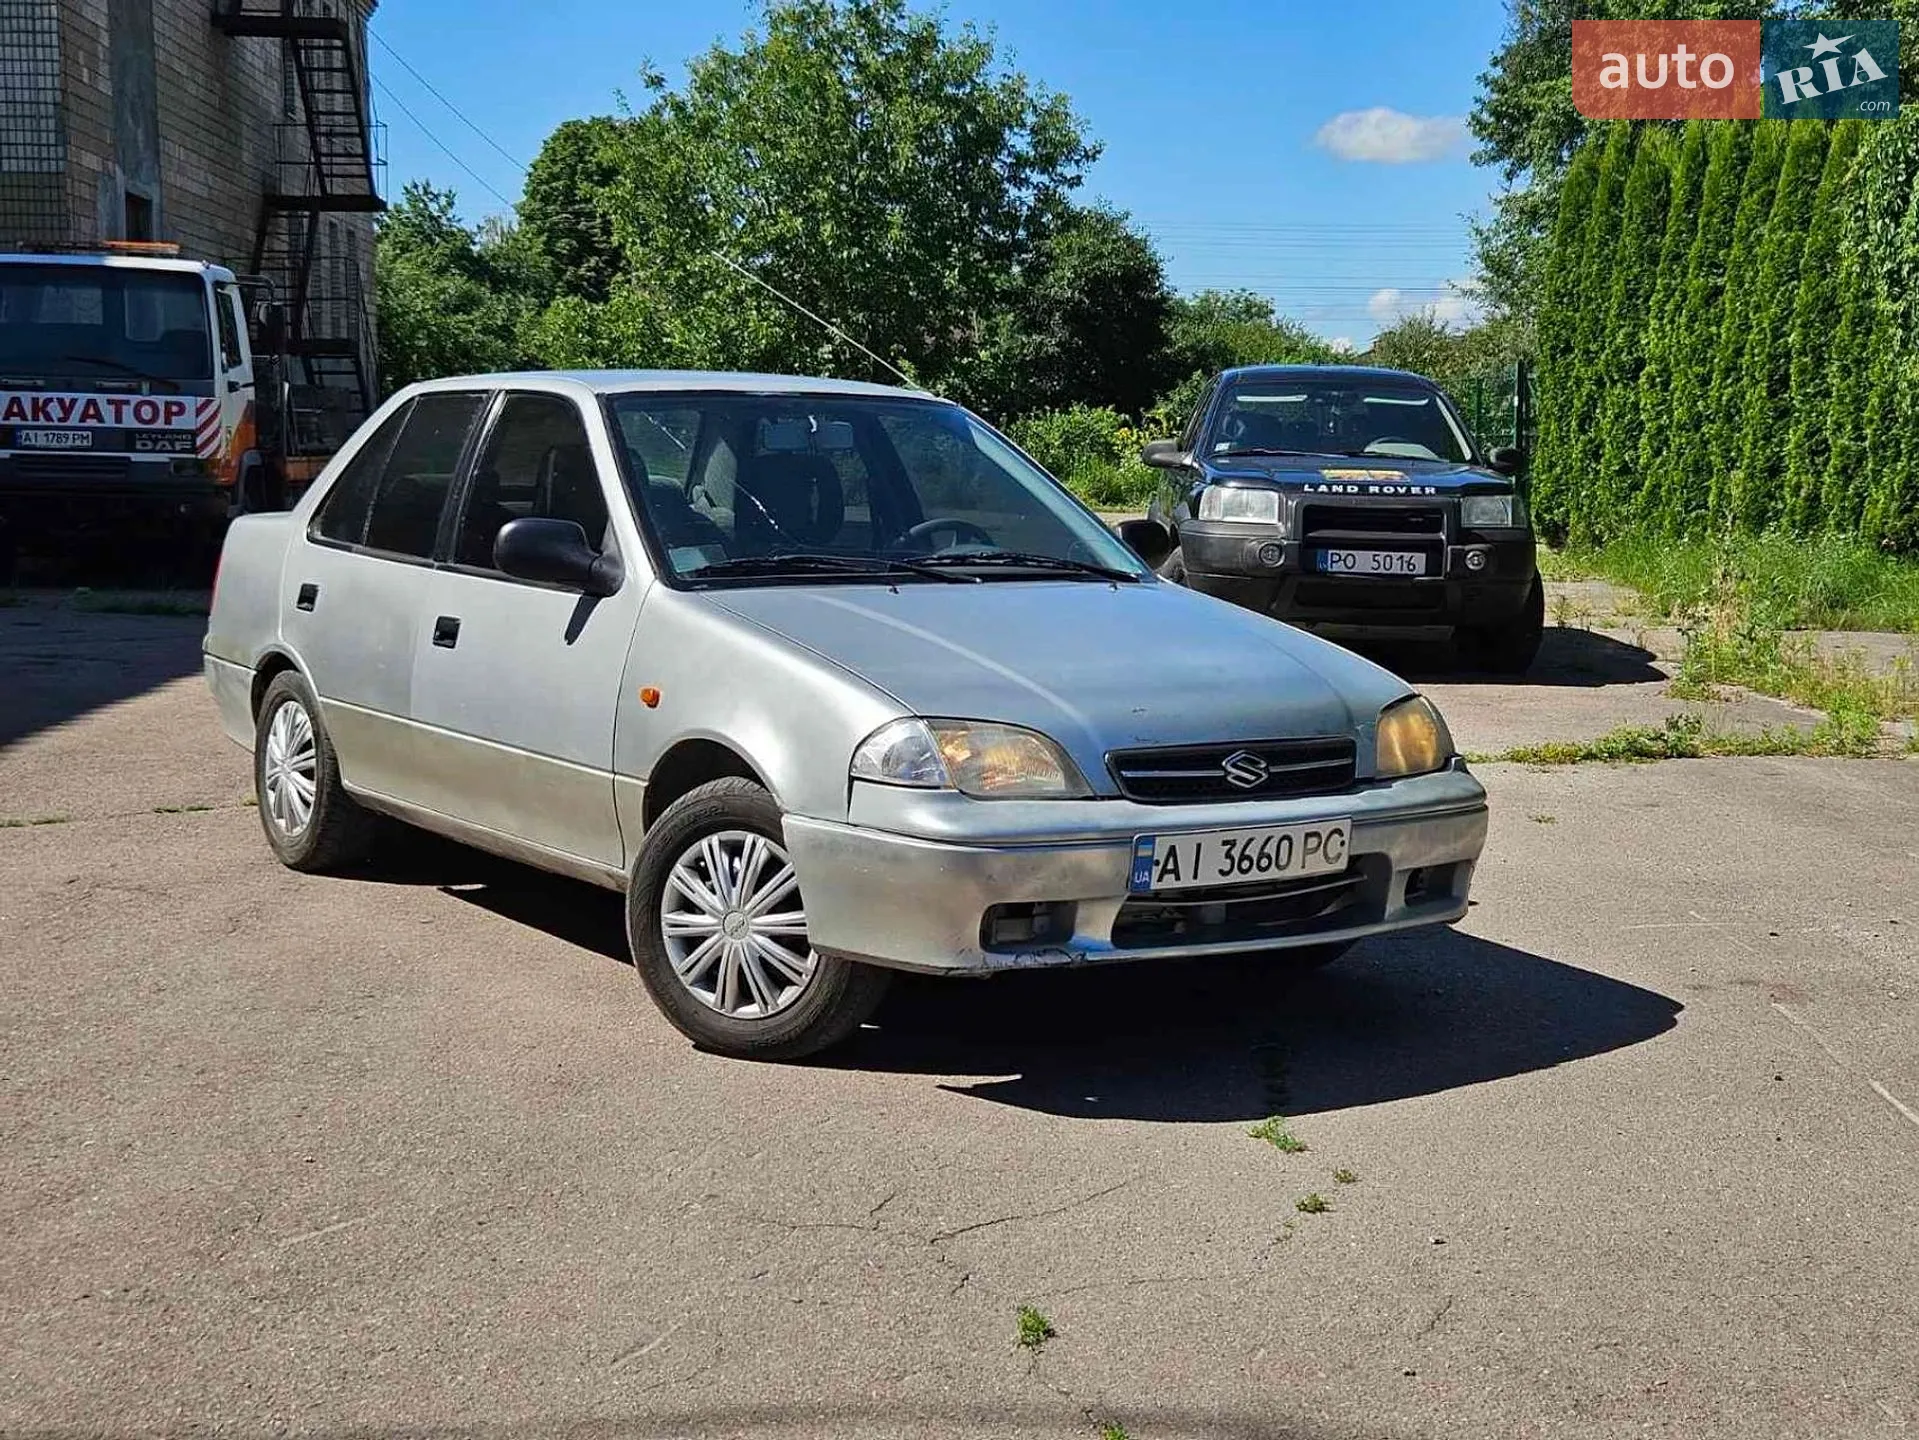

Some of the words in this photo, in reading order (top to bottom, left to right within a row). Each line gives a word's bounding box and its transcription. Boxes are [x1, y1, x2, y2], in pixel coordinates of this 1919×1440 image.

[1, 395, 187, 426] АКУАТОР
[43, 431, 69, 445] 1789
[71, 433, 90, 444] PM
[135, 440, 192, 451] DAF
[1303, 484, 1359, 493] LAND
[1368, 485, 1436, 495] ROVER
[1329, 552, 1356, 570] PO
[1370, 553, 1417, 573] 5016
[1156, 842, 1202, 883] AI
[1218, 834, 1293, 877] 3660
[1301, 827, 1345, 870] PC
[1134, 871, 1150, 884] UA
